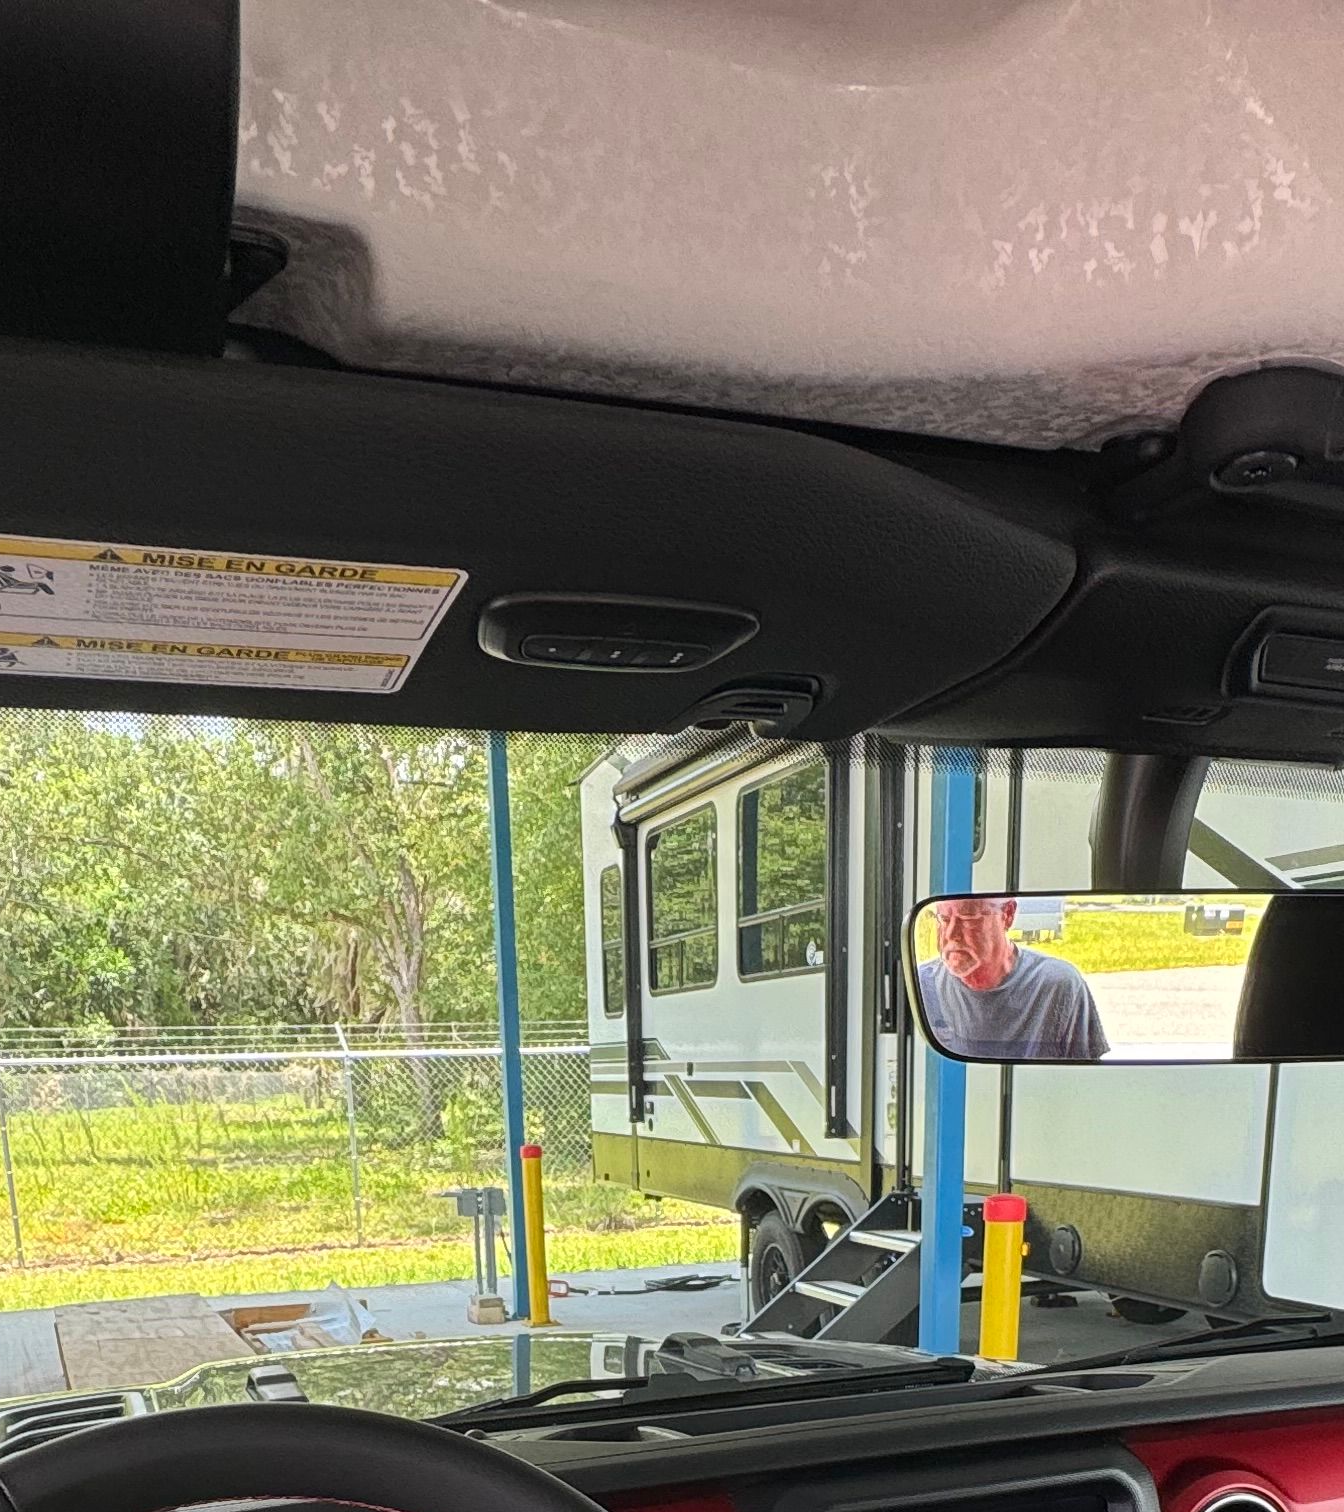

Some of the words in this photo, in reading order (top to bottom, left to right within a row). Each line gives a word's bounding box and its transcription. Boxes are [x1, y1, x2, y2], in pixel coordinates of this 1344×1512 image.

[142, 552, 215, 569] MISE
[225, 559, 266, 572] EN
[275, 563, 379, 580] GARDE
[174, 570, 202, 579] DES
[206, 573, 242, 582] SACS
[76, 638, 144, 652] MISE
[151, 642, 188, 654] EN
[196, 645, 291, 660] GARDE
